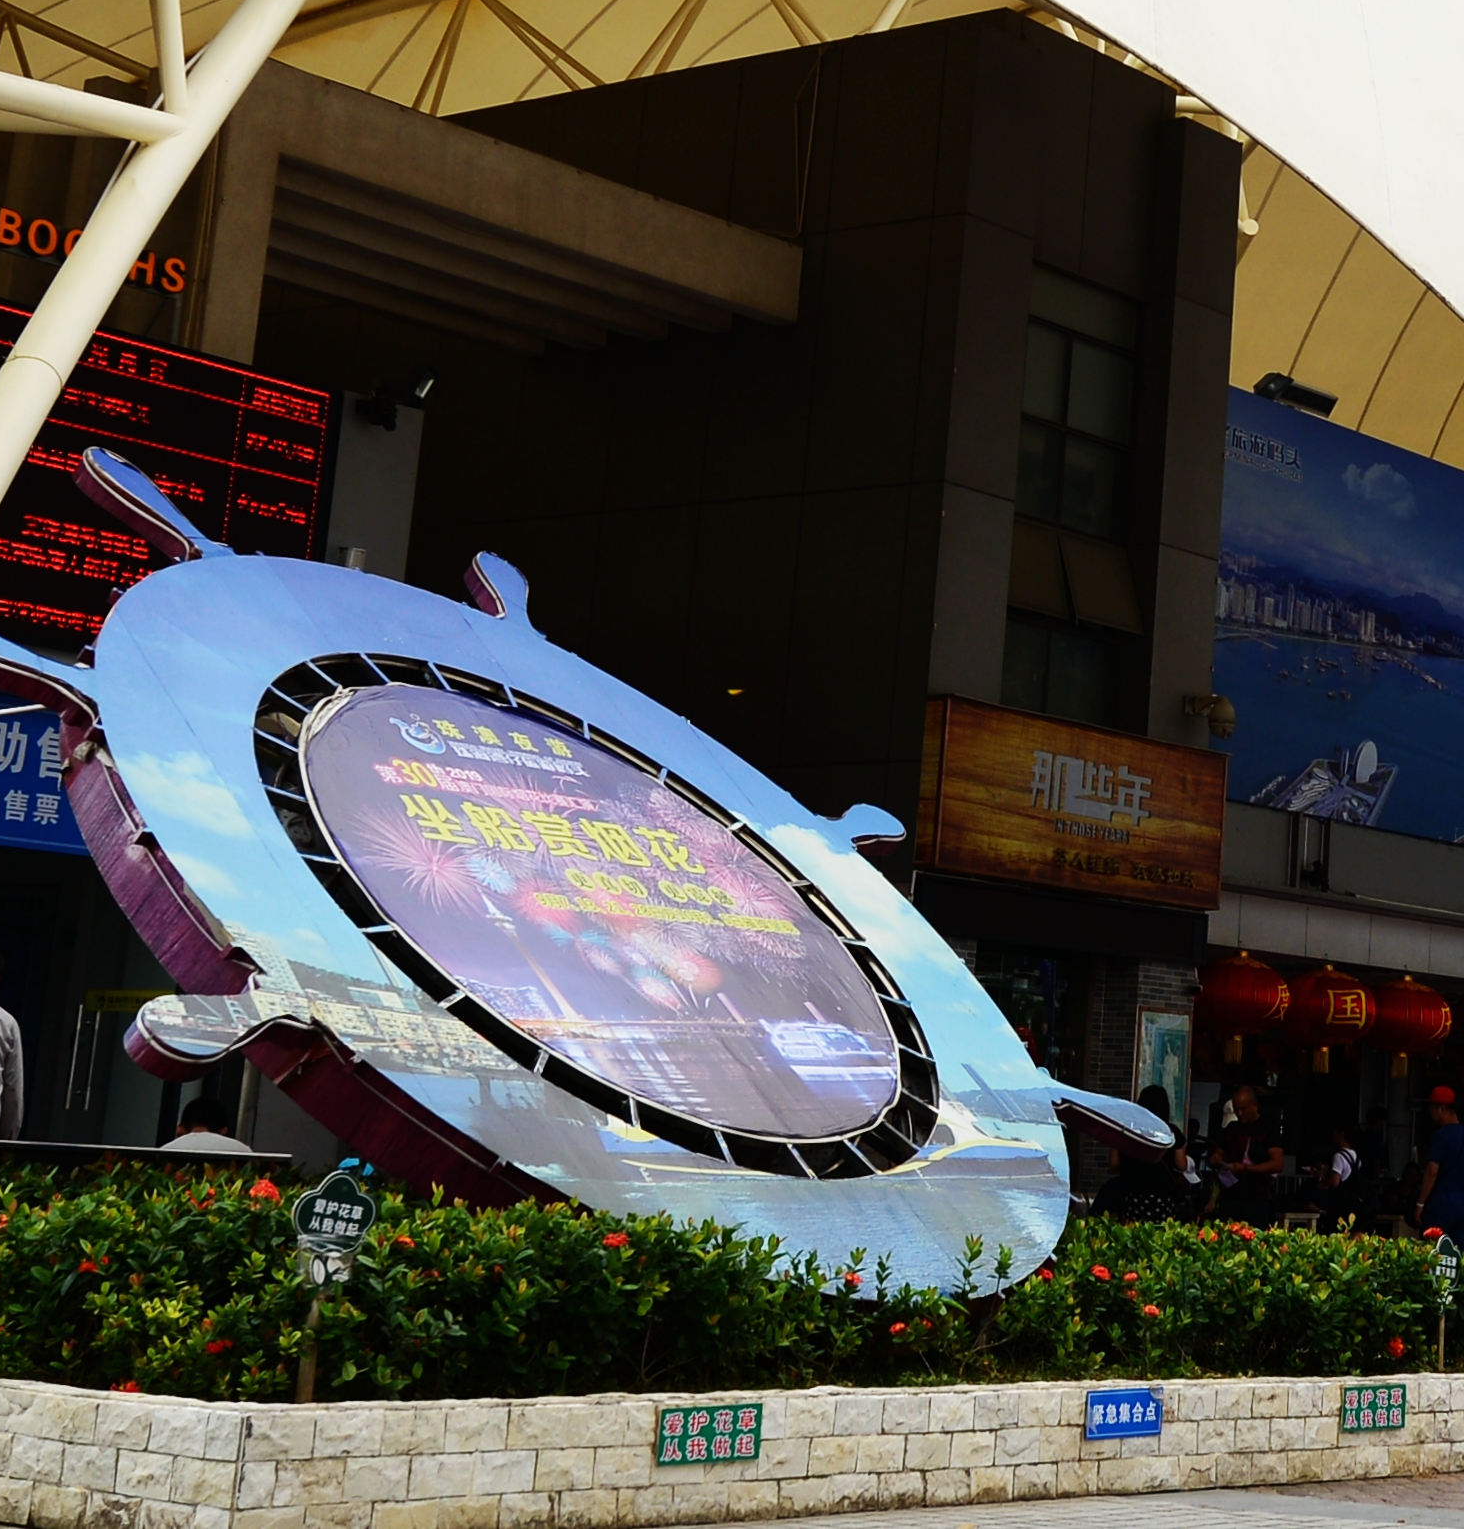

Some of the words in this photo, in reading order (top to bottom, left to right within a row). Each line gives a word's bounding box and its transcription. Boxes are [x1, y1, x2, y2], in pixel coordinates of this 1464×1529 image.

[1225, 423, 1302, 471] 旅游码头
[1031, 750, 1153, 827] 那些年
[399, 794, 707, 875] 坐船赏烟花
[1065, 821, 1097, 838] THOSE
[1099, 826, 1131, 845] YEARS
[1326, 989, 1367, 1030] 国
[313, 1198, 364, 1221] 爱护花草
[308, 1215, 360, 1237] 从我做起
[1344, 1388, 1403, 1409] 爱护花草
[662, 1407, 757, 1437] 爱护花草
[1091, 1401, 1157, 1426] 紧急集合点
[1343, 1408, 1402, 1430] 从我做起
[659, 1433, 755, 1462] 从我做起
